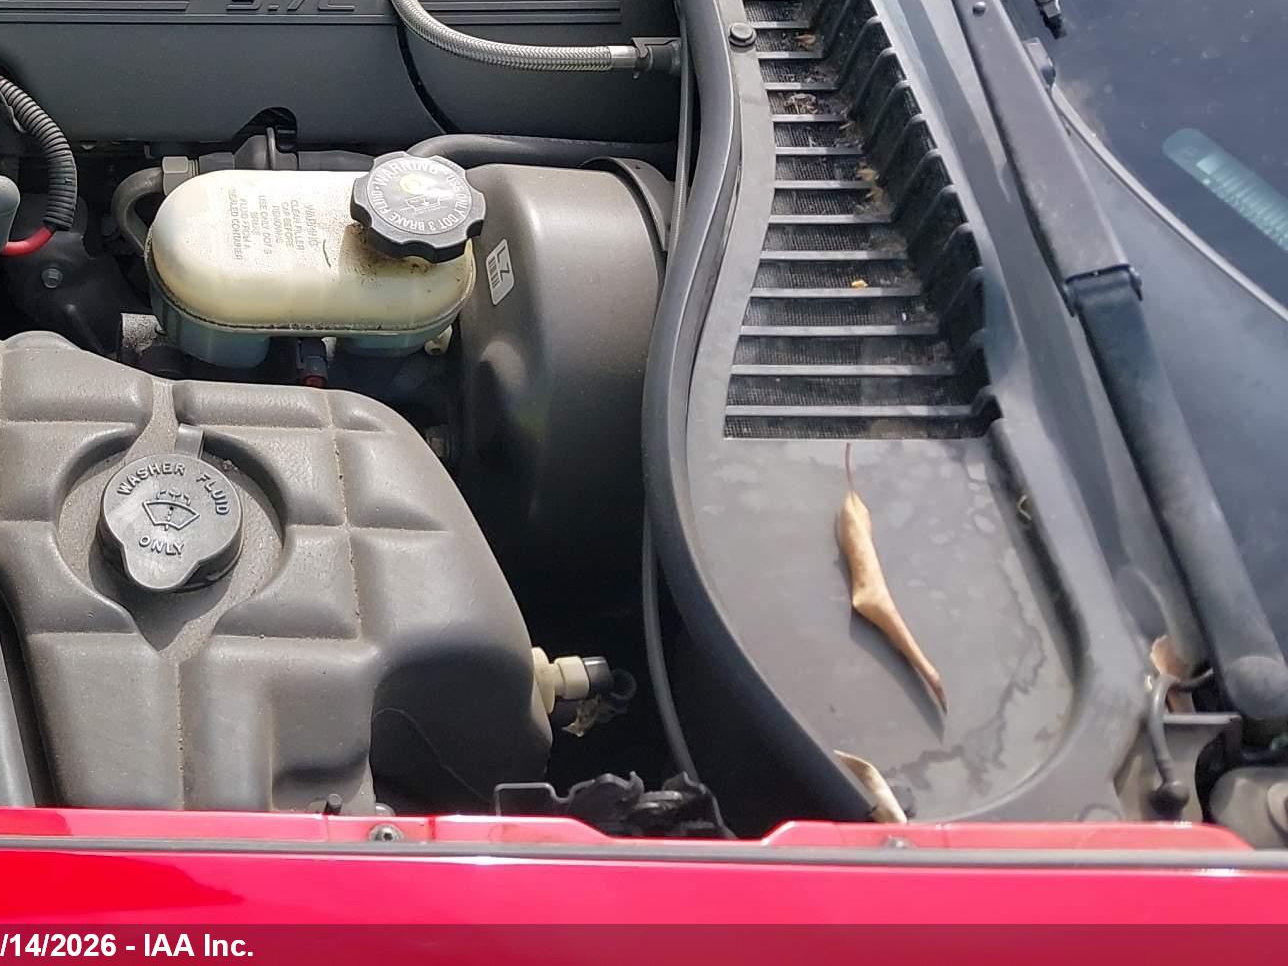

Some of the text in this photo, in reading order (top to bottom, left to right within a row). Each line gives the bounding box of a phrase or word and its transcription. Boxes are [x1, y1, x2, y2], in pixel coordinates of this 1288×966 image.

[372, 159, 439, 186] WARNING
[372, 189, 391, 215] FLUID
[388, 211, 425, 231] BRAKE
[428, 221, 437, 231] 3
[438, 213, 460, 230] DOT
[116, 463, 230, 516] WASHER FLUID
[139, 535, 185, 556] ONLY
